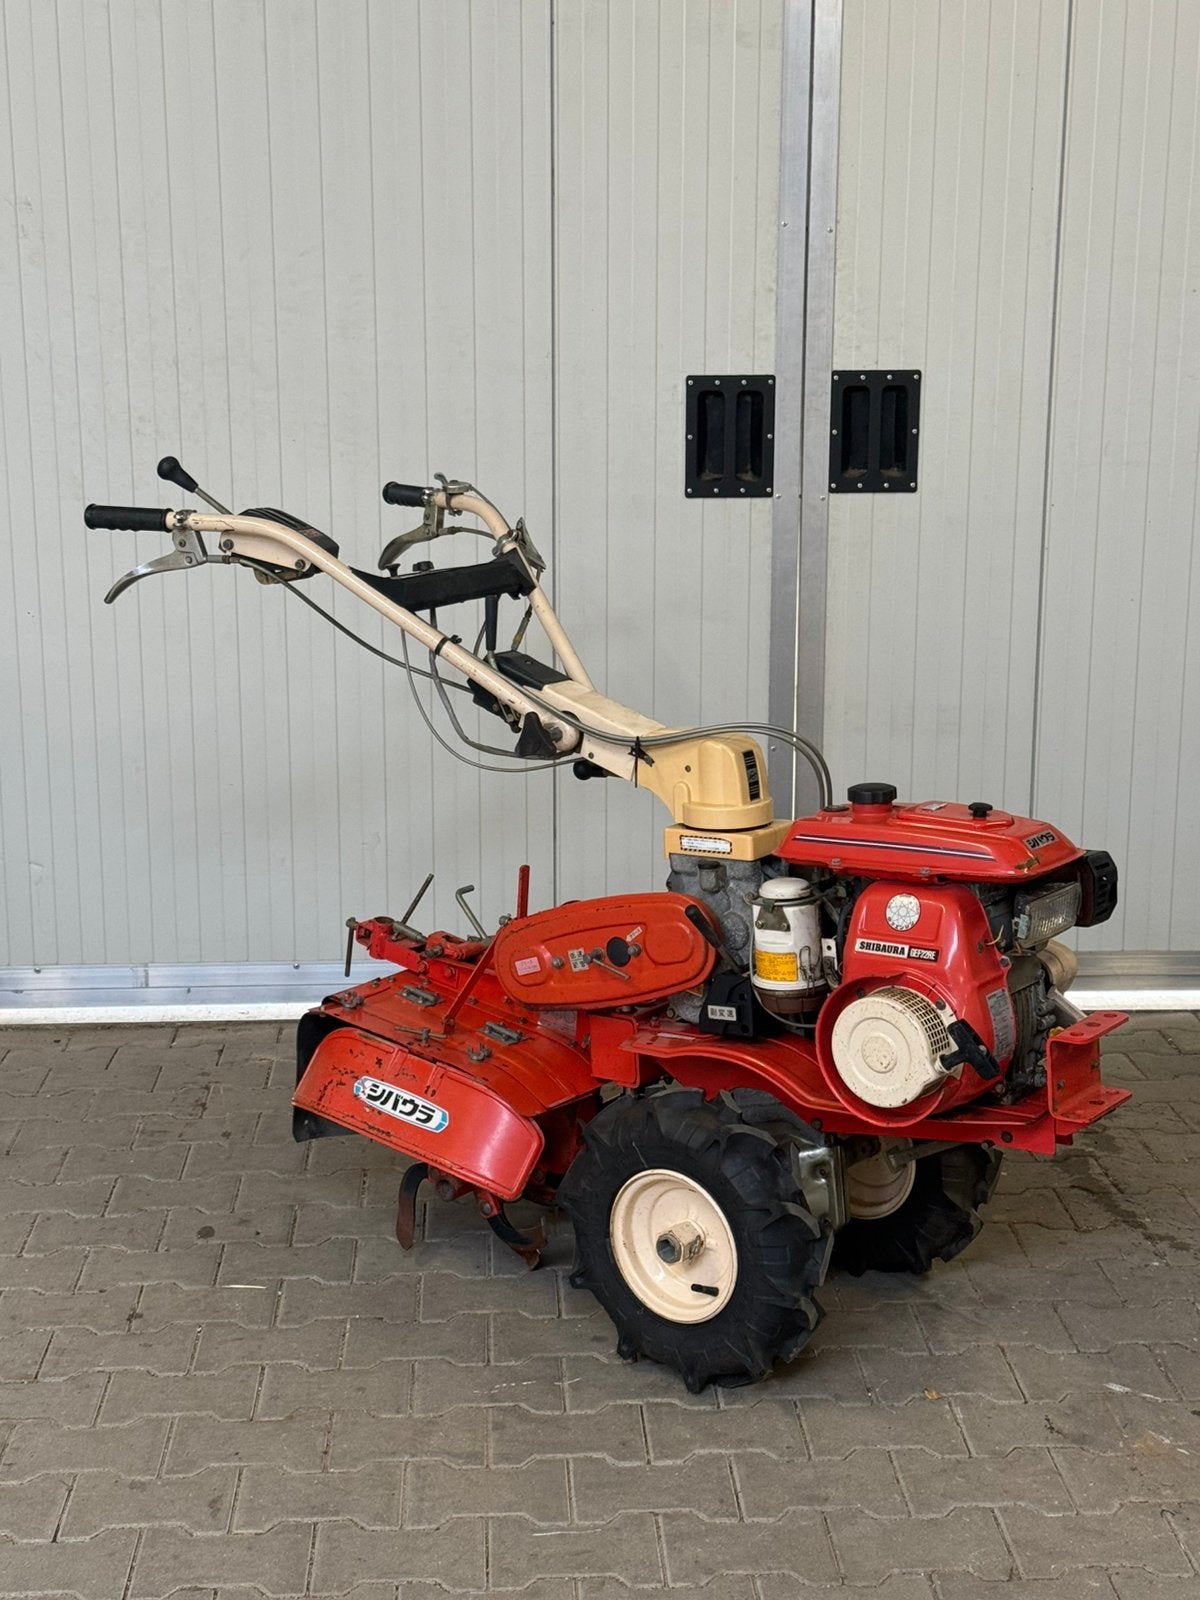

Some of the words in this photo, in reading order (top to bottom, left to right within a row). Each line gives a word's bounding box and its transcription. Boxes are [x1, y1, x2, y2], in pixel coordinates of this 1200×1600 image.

[860, 941, 905, 956] SHIBAURA
[366, 1083, 436, 1124] シバウラ
